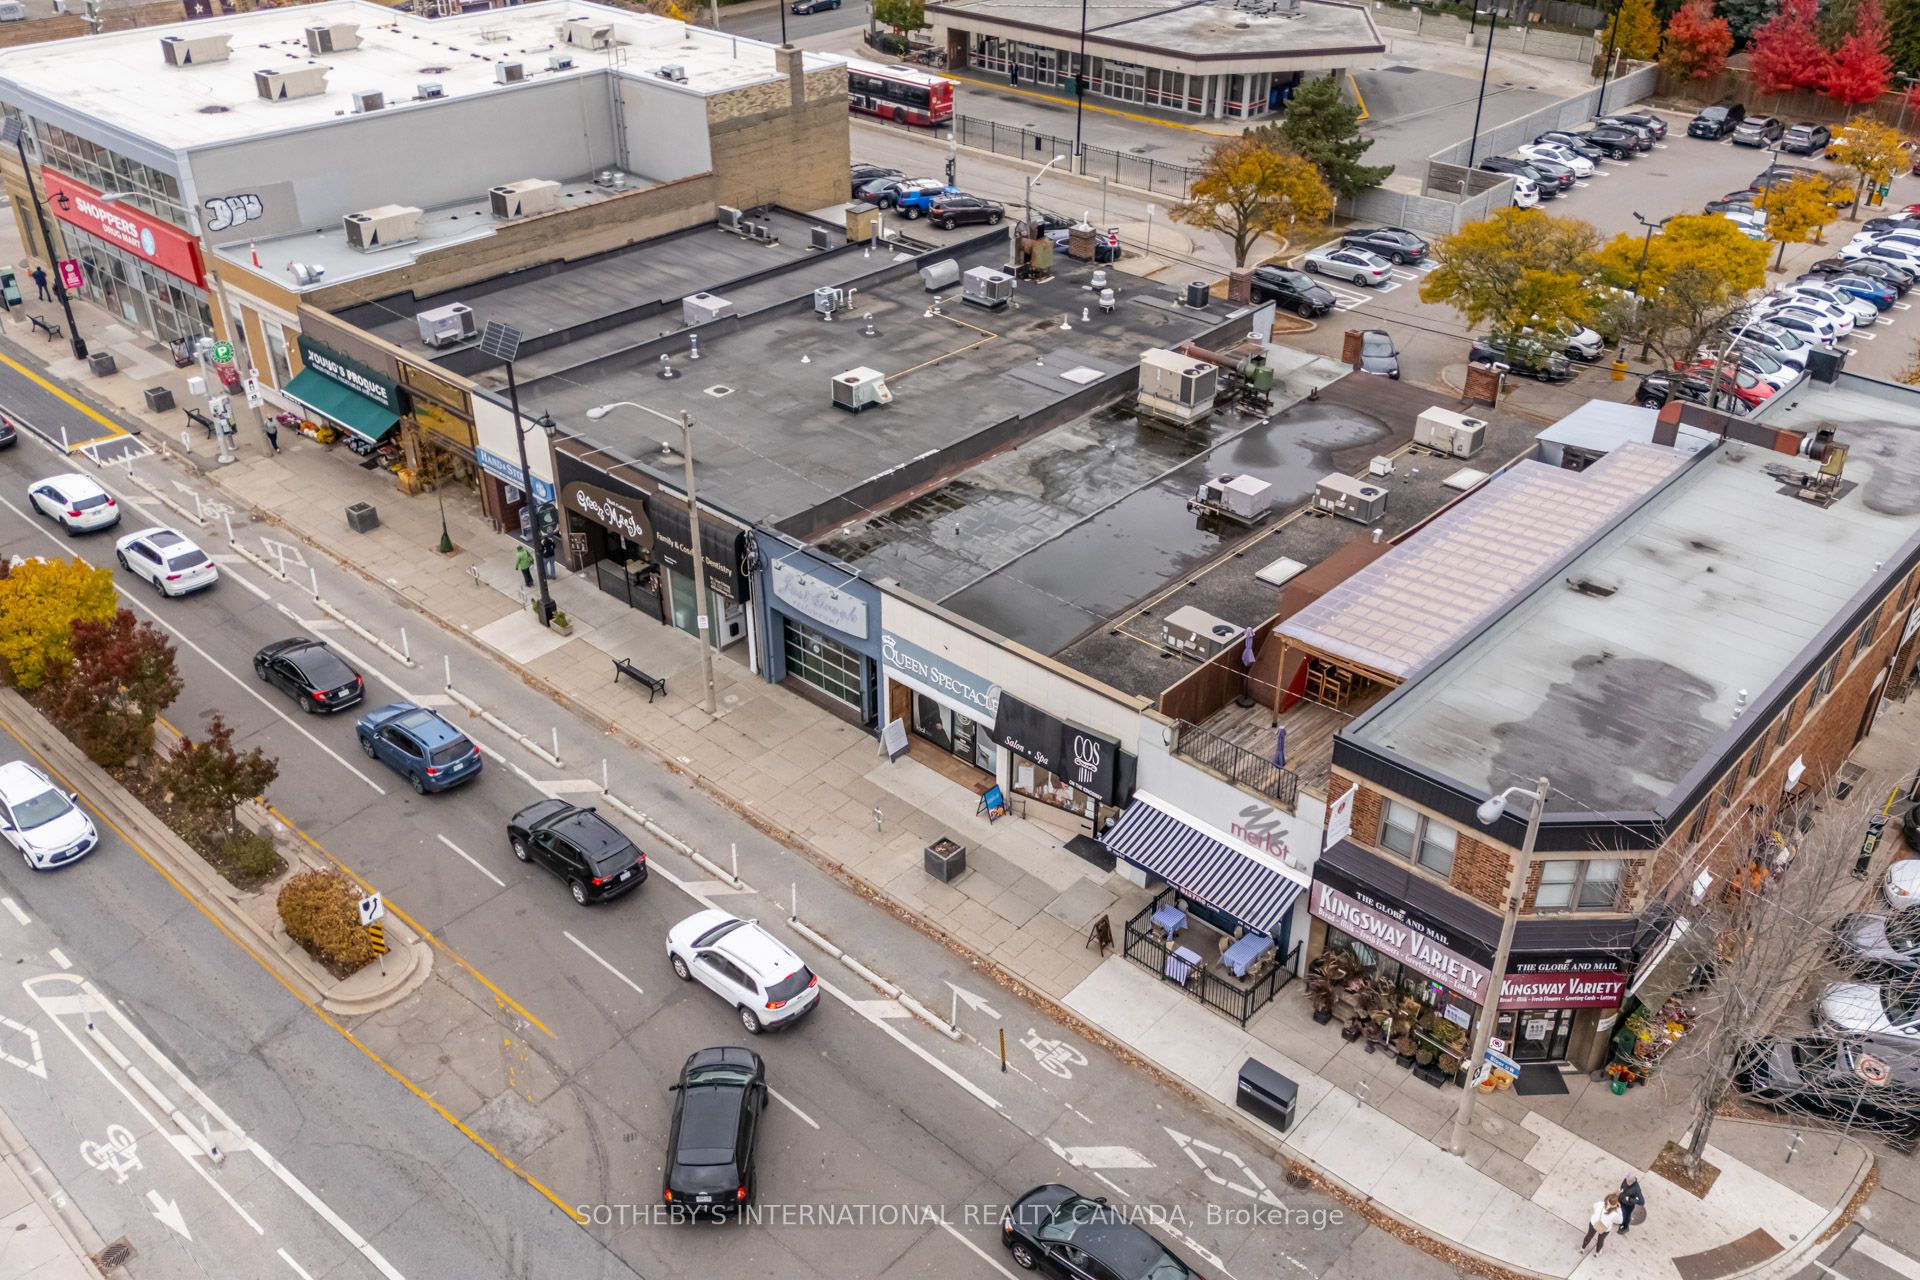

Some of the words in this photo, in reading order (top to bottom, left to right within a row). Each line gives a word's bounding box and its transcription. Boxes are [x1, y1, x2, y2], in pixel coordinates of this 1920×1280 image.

[75, 197, 138, 238] SHOPPERS
[102, 223, 122, 240] DRUG
[121, 233, 140, 248] MART
[217, 346, 227, 356] P
[307, 349, 345, 377] YOUNG'S
[346, 369, 388, 399] PRODUCE
[480, 451, 503, 469] HAND
[657, 531, 674, 547] Family
[706, 556, 733, 577] Dentistry
[883, 644, 928, 677] QUEEN
[1005, 736, 1024, 752] Salon
[1034, 751, 1049, 766] Spa
[1074, 735, 1100, 766] COS
[1231, 822, 1290, 861] merlot
[1356, 891, 1374, 906] THE
[1376, 903, 1404, 921] GLOBE
[1406, 918, 1424, 932] AND
[1427, 929, 1449, 945] MAIL
[1320, 884, 1407, 949] KINGSWAY
[1411, 930, 1484, 989] VARIETY
[1517, 963, 1536, 971] THE
[1538, 963, 1568, 971] GLOBE
[1571, 962, 1591, 970] AND
[1593, 962, 1618, 970] MAIL
[1454, 981, 1477, 999] Lottery
[1500, 980, 1566, 996] KINGSWAY
[1569, 978, 1623, 994] VARIETY
